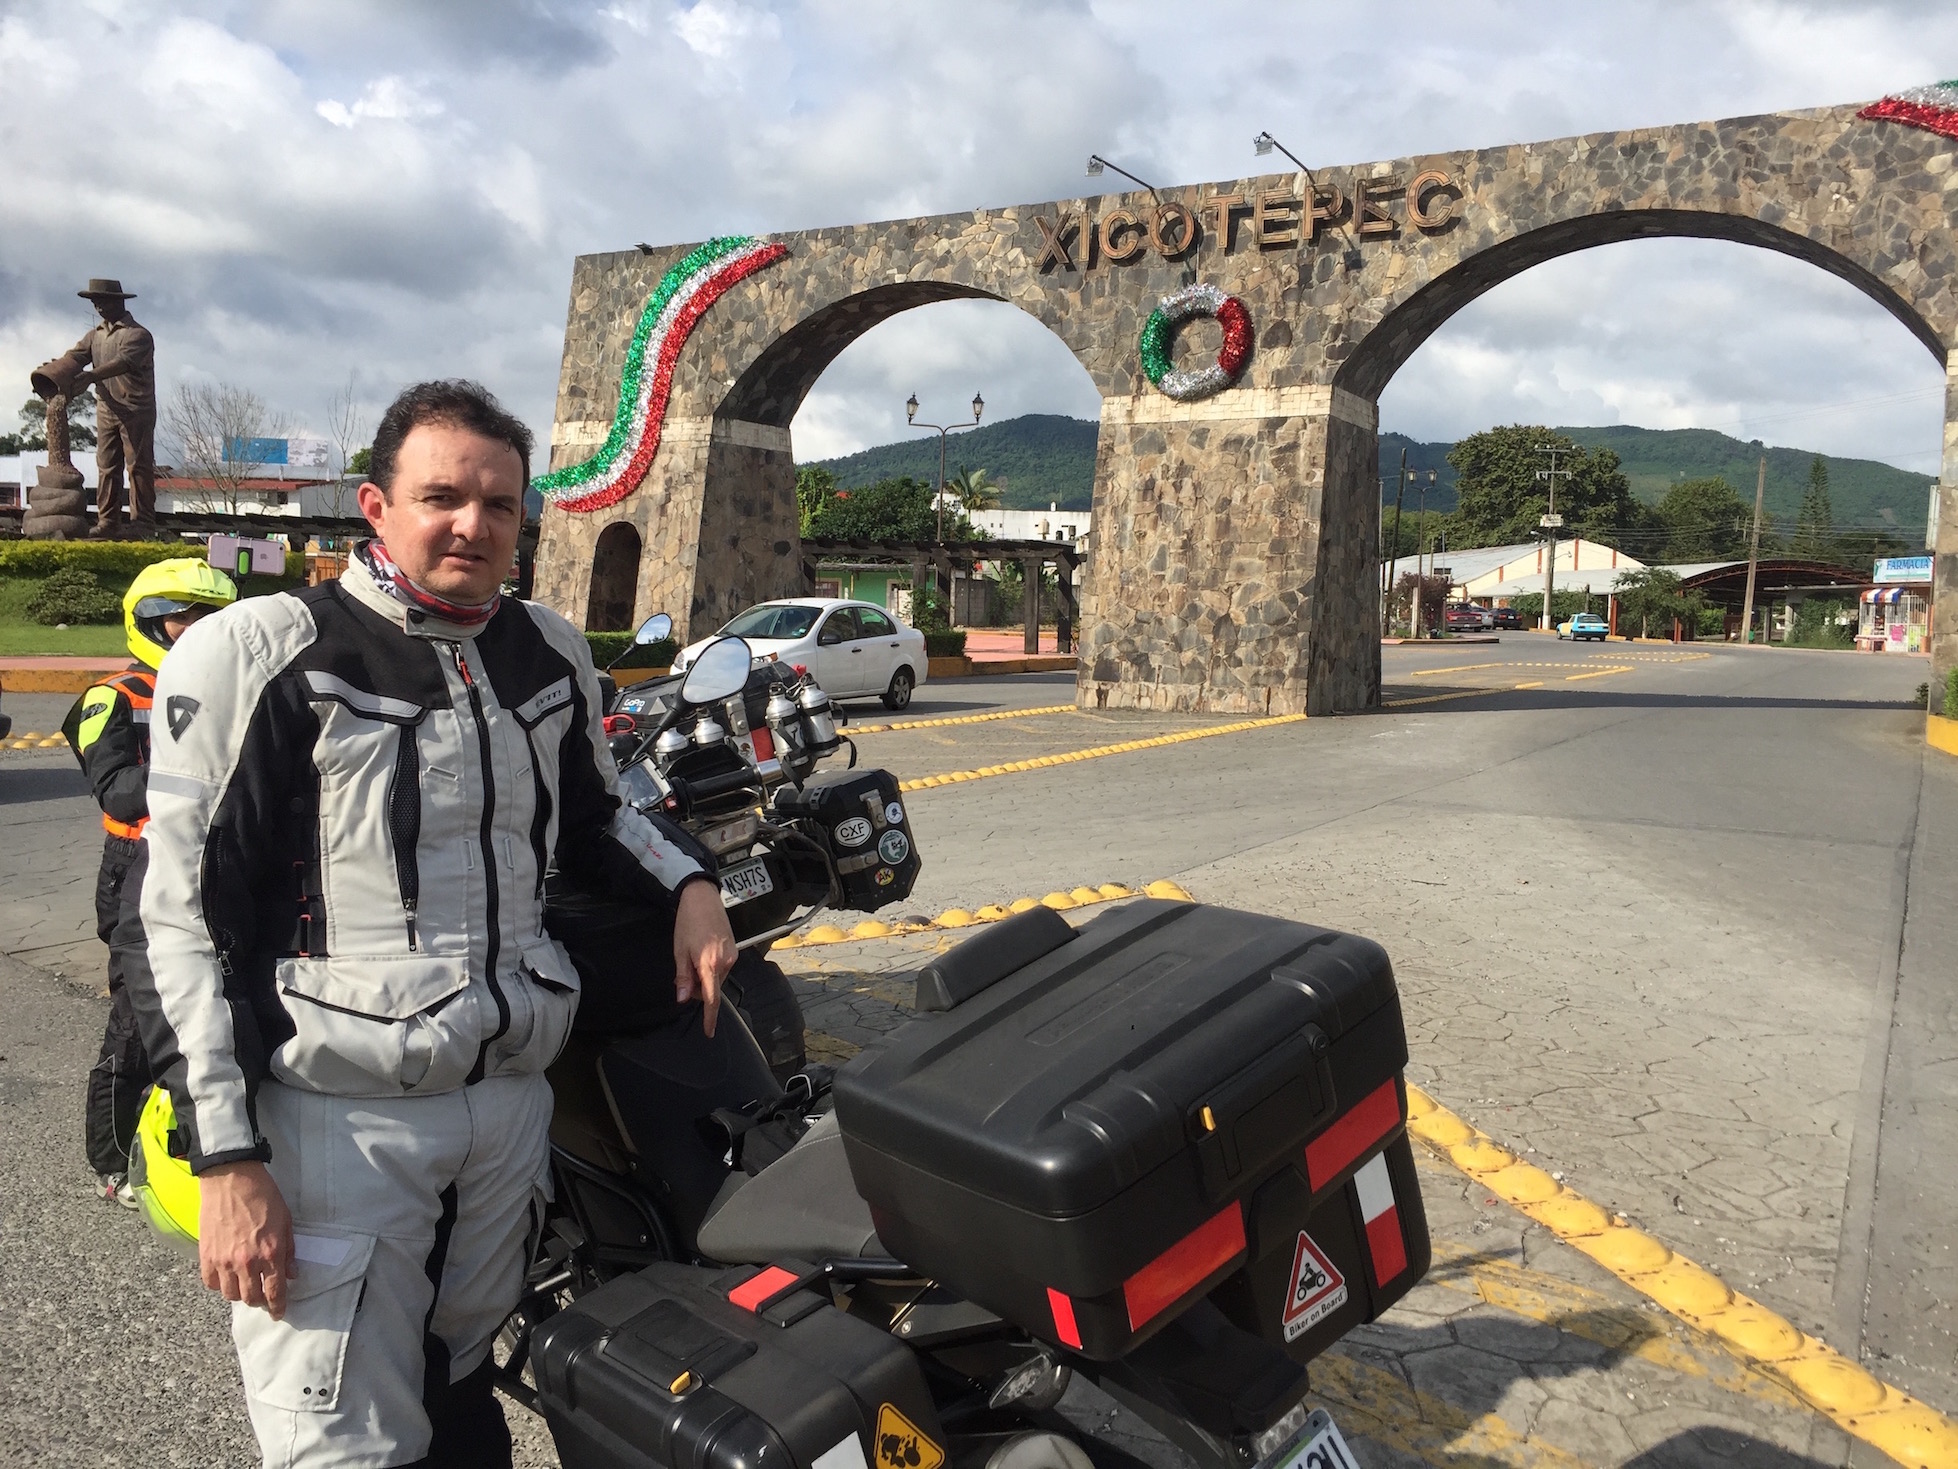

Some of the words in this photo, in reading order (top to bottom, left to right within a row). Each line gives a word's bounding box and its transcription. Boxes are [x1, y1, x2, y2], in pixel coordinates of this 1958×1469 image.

[1033, 169, 1454, 266] XICOTEPEC
[1886, 559, 1929, 570] FARMACIA
[623, 698, 646, 707] GoPro
[840, 822, 865, 838] CXF
[1289, 1317, 1309, 1336] Biker
[1310, 1310, 1320, 1321] on
[1320, 1291, 1344, 1314] Board
